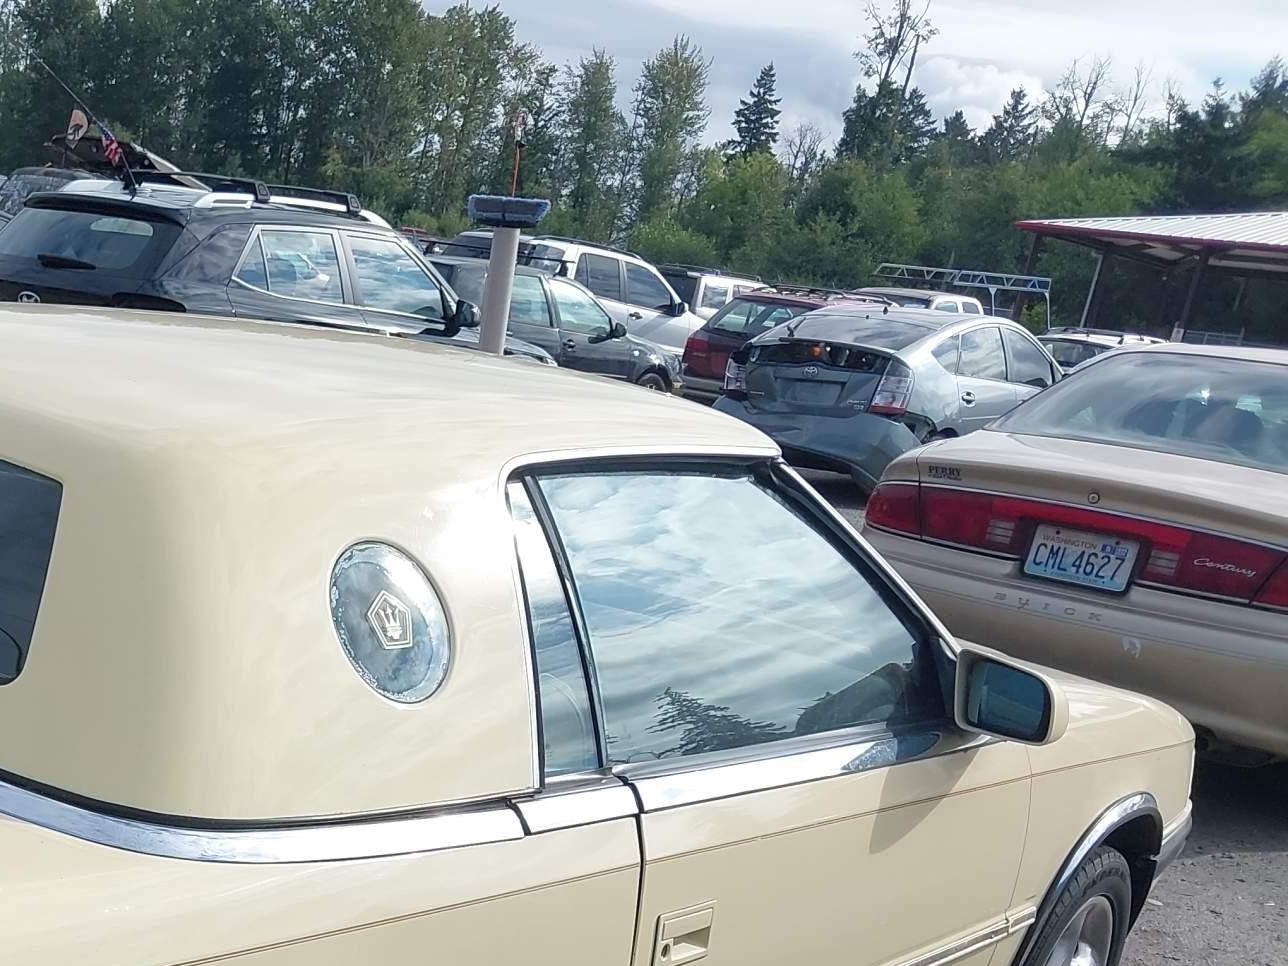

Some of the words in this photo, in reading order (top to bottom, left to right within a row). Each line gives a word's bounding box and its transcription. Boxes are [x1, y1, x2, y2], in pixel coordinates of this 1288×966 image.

[1042, 534, 1099, 551] WASHINGTON
[1032, 542, 1126, 581] CML4627
[1193, 558, 1257, 578] Century
[993, 592, 1103, 622] BUICK
